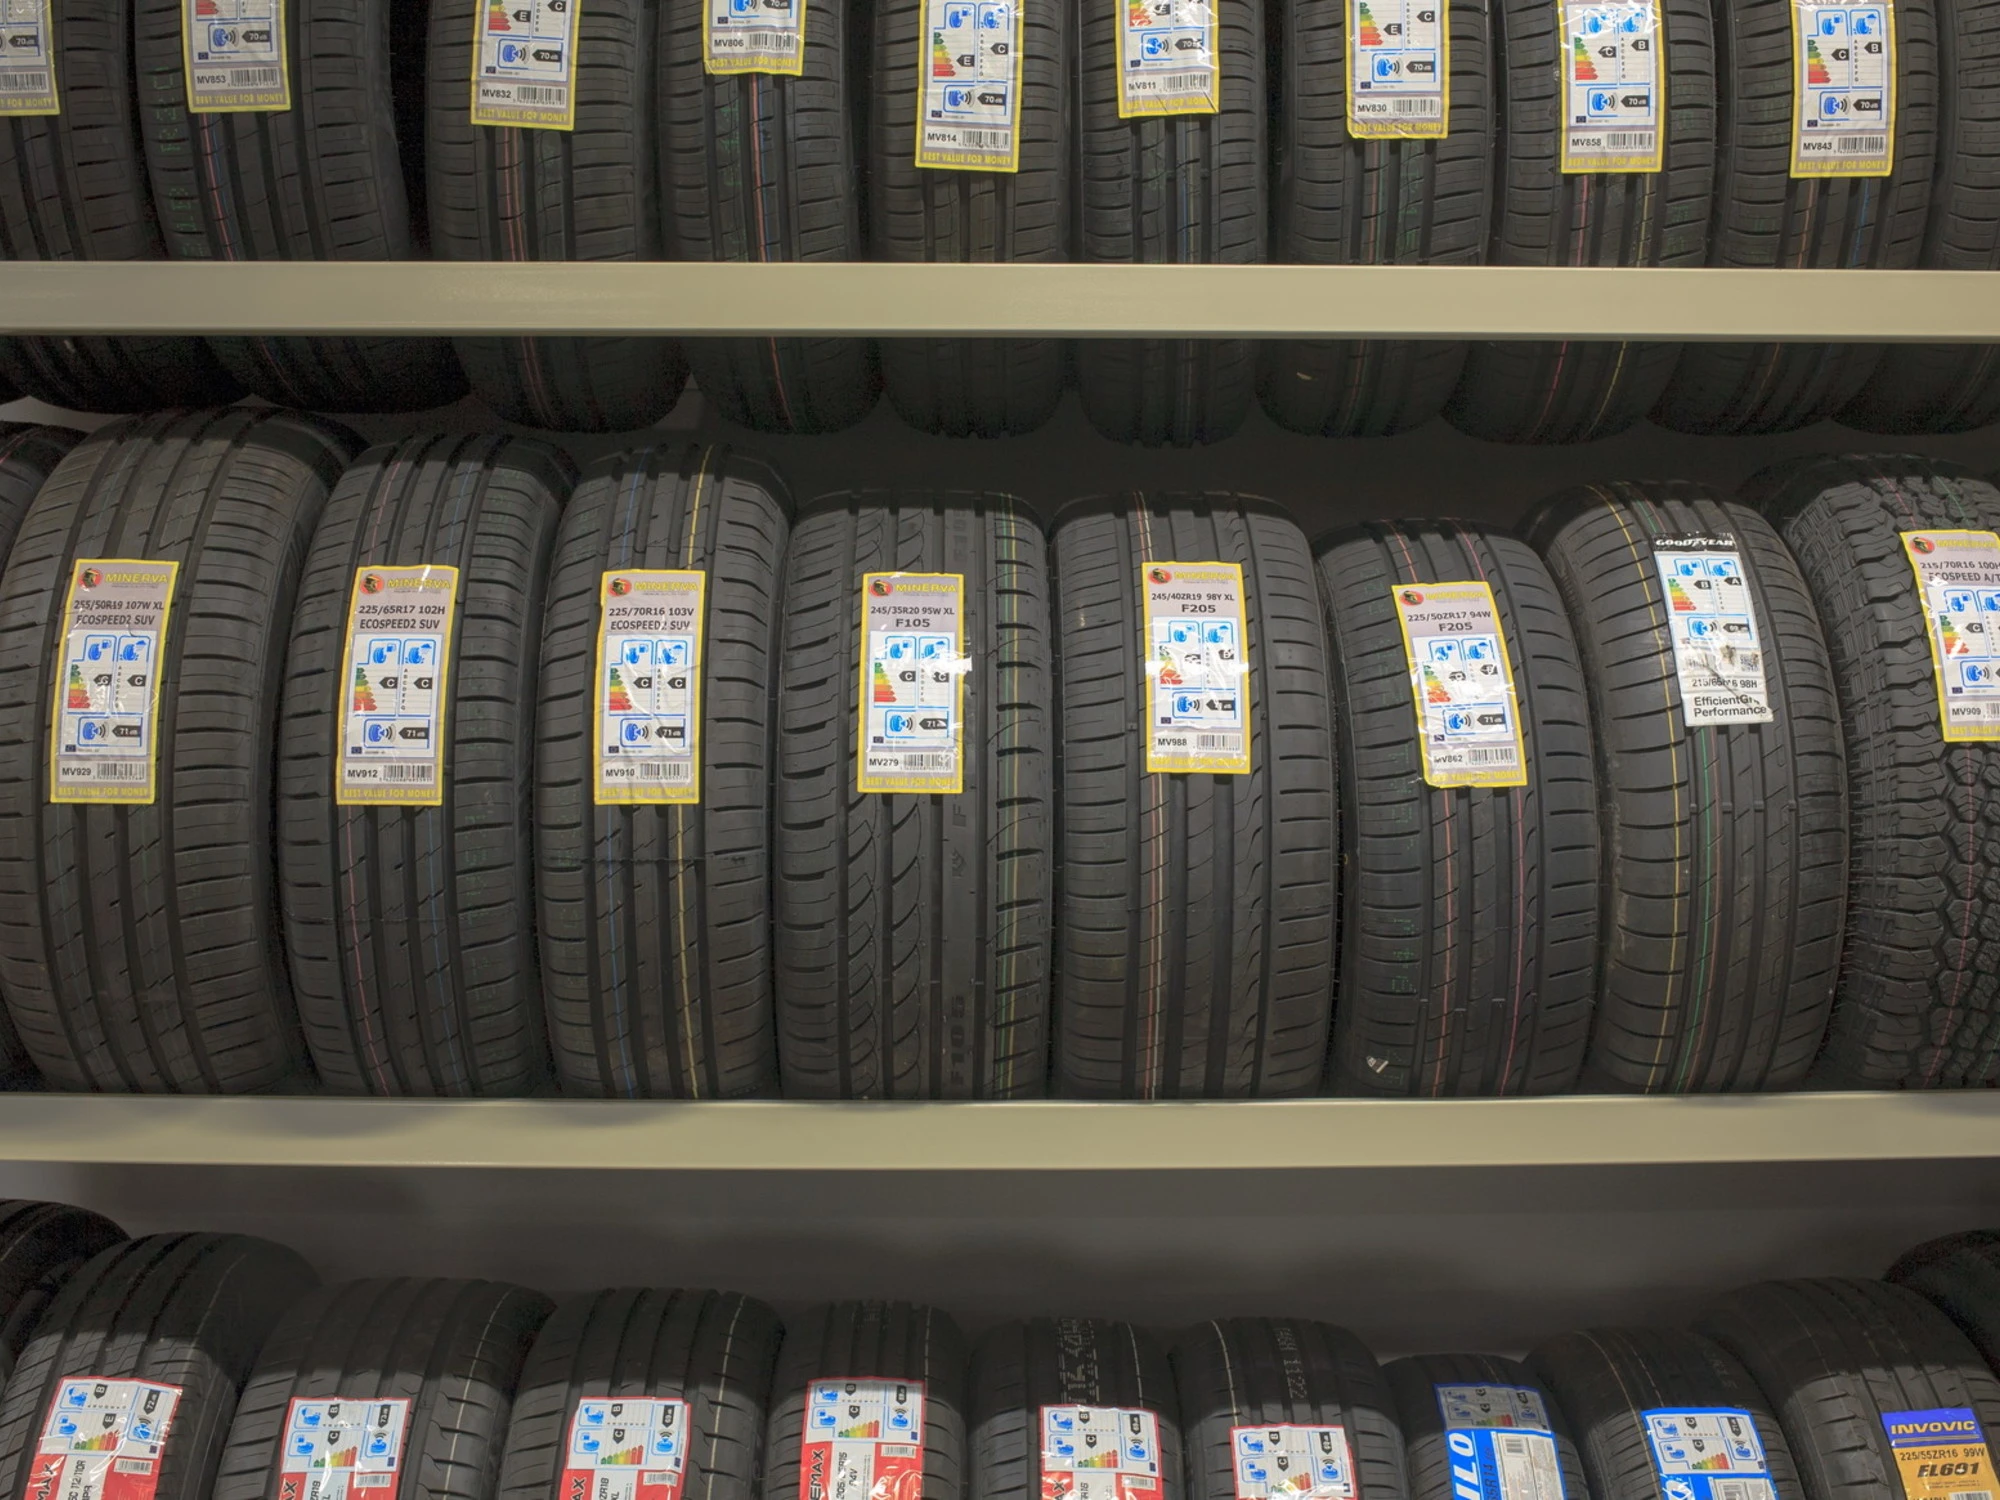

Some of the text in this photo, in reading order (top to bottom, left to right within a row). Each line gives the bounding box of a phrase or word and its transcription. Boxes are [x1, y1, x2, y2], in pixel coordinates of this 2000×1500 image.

[554, 2, 563, 11] C
[519, 12, 527, 21] E
[1424, 12, 1432, 21] C
[1391, 25, 1398, 34] E
[998, 44, 1005, 54] C
[1638, 41, 1646, 50] B
[1871, 44, 1879, 52] B
[1605, 47, 1613, 56] C
[1839, 50, 1846, 59] C
[964, 56, 971, 66] E
[196, 75, 226, 85] MV853
[482, 89, 512, 98] MV832
[985, 95, 994, 103] 70
[1357, 104, 1387, 113] MV830
[927, 133, 957, 142] MV814
[1572, 138, 1602, 146] MV858
[1803, 142, 1832, 150] MV843
[923, 151, 1011, 165] BEST VALUE FOR MONEY
[1798, 160, 1885, 170] BEST VALUE FOR MONEY
[1655, 537, 1734, 547] GOODYEAR
[1920, 560, 1976, 570] 215/70R16
[105, 573, 168, 583] MINERVA
[387, 579, 451, 590] MINERVA
[895, 583, 957, 593] MINERVA
[1151, 592, 1235, 602] 245/40ZR19 98Y XL
[74, 600, 164, 610] 255/50R19 107W XL
[1181, 604, 1216, 614] F205
[358, 605, 445, 616] 225/65R17 102H
[609, 607, 695, 617] 225/70R16 103V
[870, 606, 955, 616] 245/35R20 95W XL
[76, 615, 155, 626] ECOSPEED2 SUV
[1407, 610, 1491, 622] 225/50ZR17 94W
[360, 619, 440, 629] ECOSPEED2 SUV
[611, 620, 690, 631] ECOSPEED2 SUV
[895, 618, 931, 628] F105
[1438, 622, 1473, 632] F205
[1972, 624, 1980, 632] C
[135, 676, 143, 685] C
[905, 672, 913, 681] C
[387, 679, 394, 688] C
[421, 679, 429, 688] C
[641, 678, 649, 687] C
[675, 678, 683, 687] C
[1740, 679, 1758, 688] 98H
[1693, 705, 1767, 718] Performance
[120, 727, 128, 735] 71
[407, 729, 416, 737] 71
[1158, 738, 1187, 746] MV988
[869, 758, 899, 767] MV279
[62, 767, 91, 776] MV929
[347, 770, 378, 778] MV912
[605, 768, 635, 777] MV910
[146, 1401, 154, 1410] 72
[105, 1414, 114, 1422] E
[1890, 1420, 1976, 1435] INVOVIC
[1899, 1447, 1986, 1461] 225/55ZR16 99W
